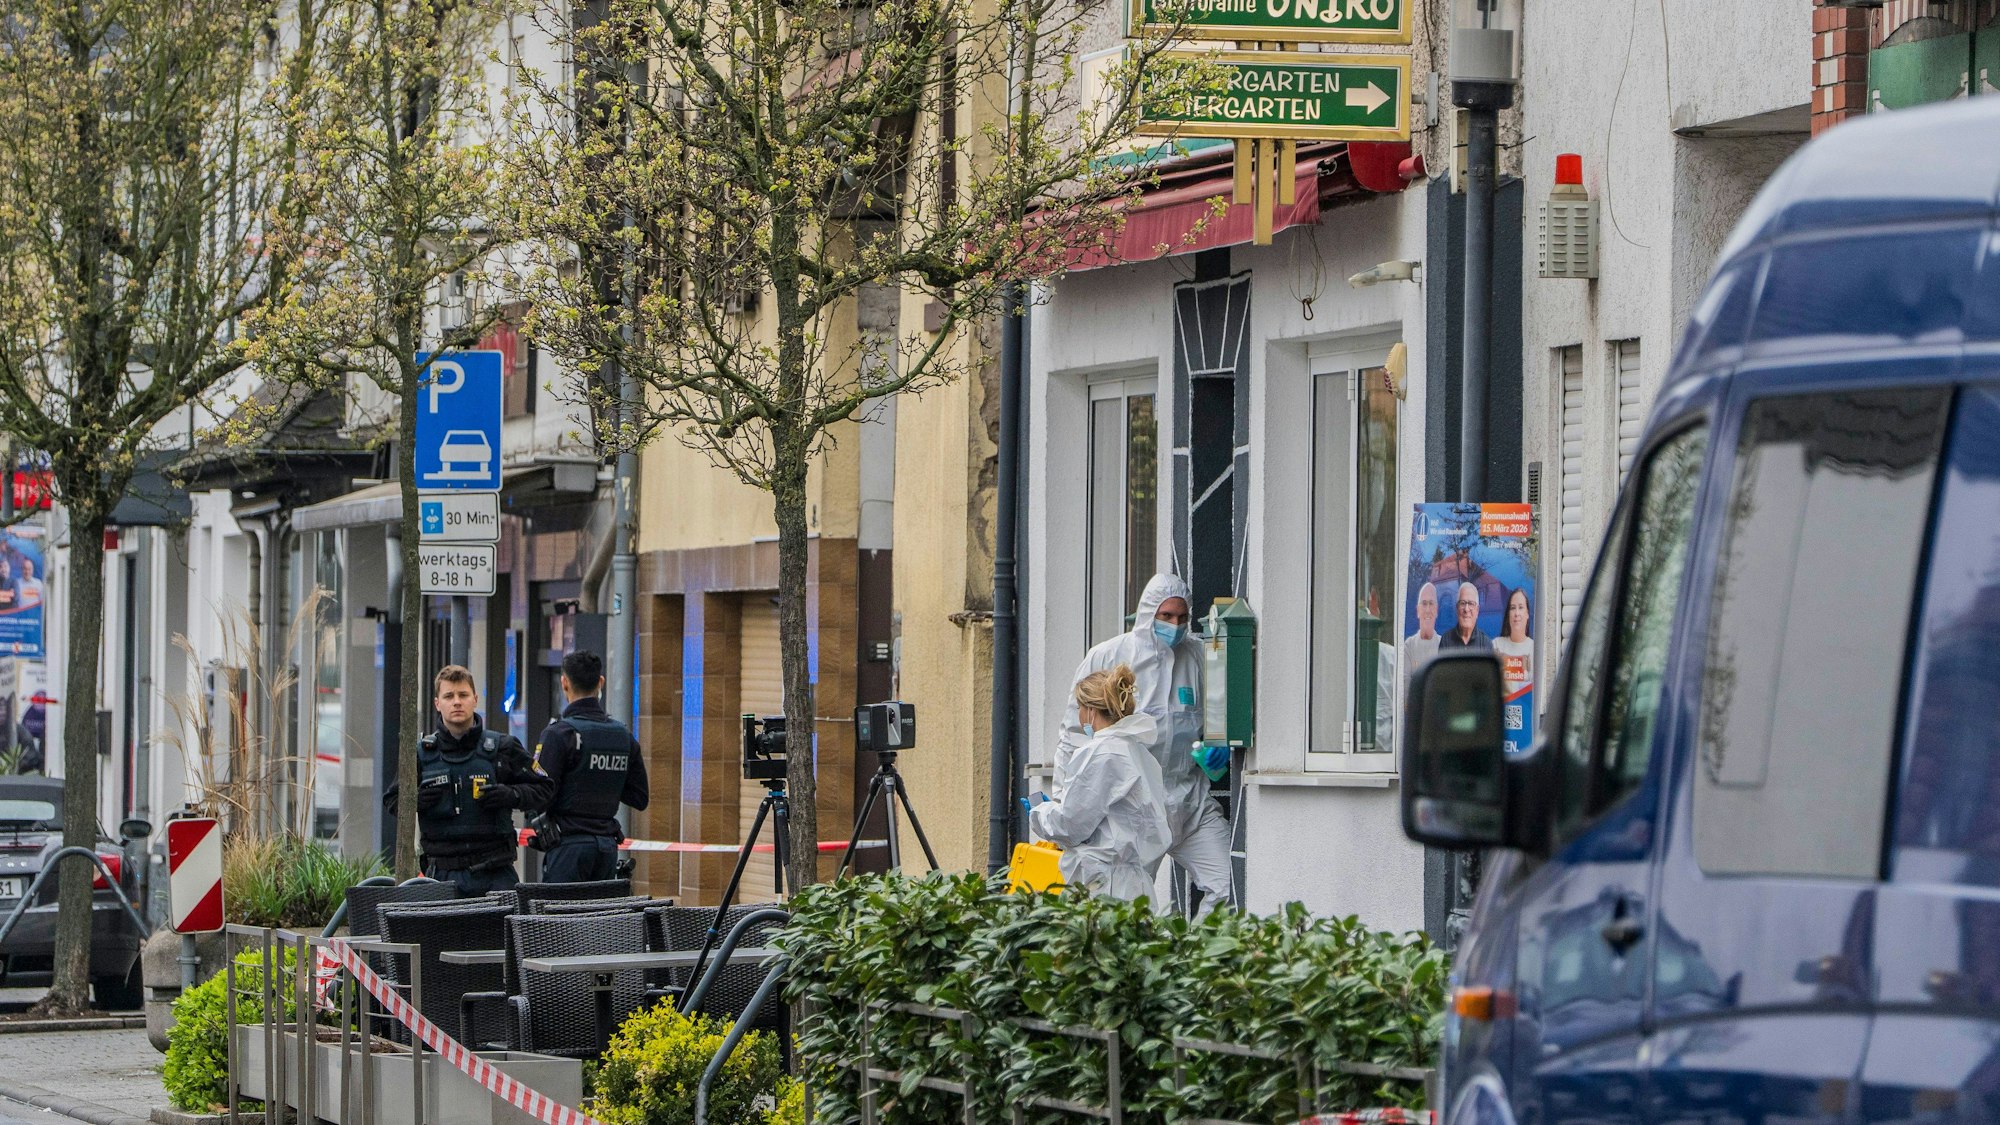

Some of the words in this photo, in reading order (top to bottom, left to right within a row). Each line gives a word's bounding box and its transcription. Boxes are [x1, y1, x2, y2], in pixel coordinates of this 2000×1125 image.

[1168, 95, 1321, 121] IERGARTEN
[429, 360, 465, 414] P
[446, 511, 462, 525] 30
[467, 511, 493, 525] Min.
[1483, 512, 1530, 520] Kommunalwahl
[1483, 524, 1493, 533] 15.
[1493, 523, 1510, 533] März
[1510, 523, 1529, 533] 2026
[419, 552, 487, 570] werktags
[431, 571, 459, 587] 8-18
[465, 572, 473, 586] h
[1507, 658, 1523, 668] Julia
[590, 754, 629, 771] POLIZEI
